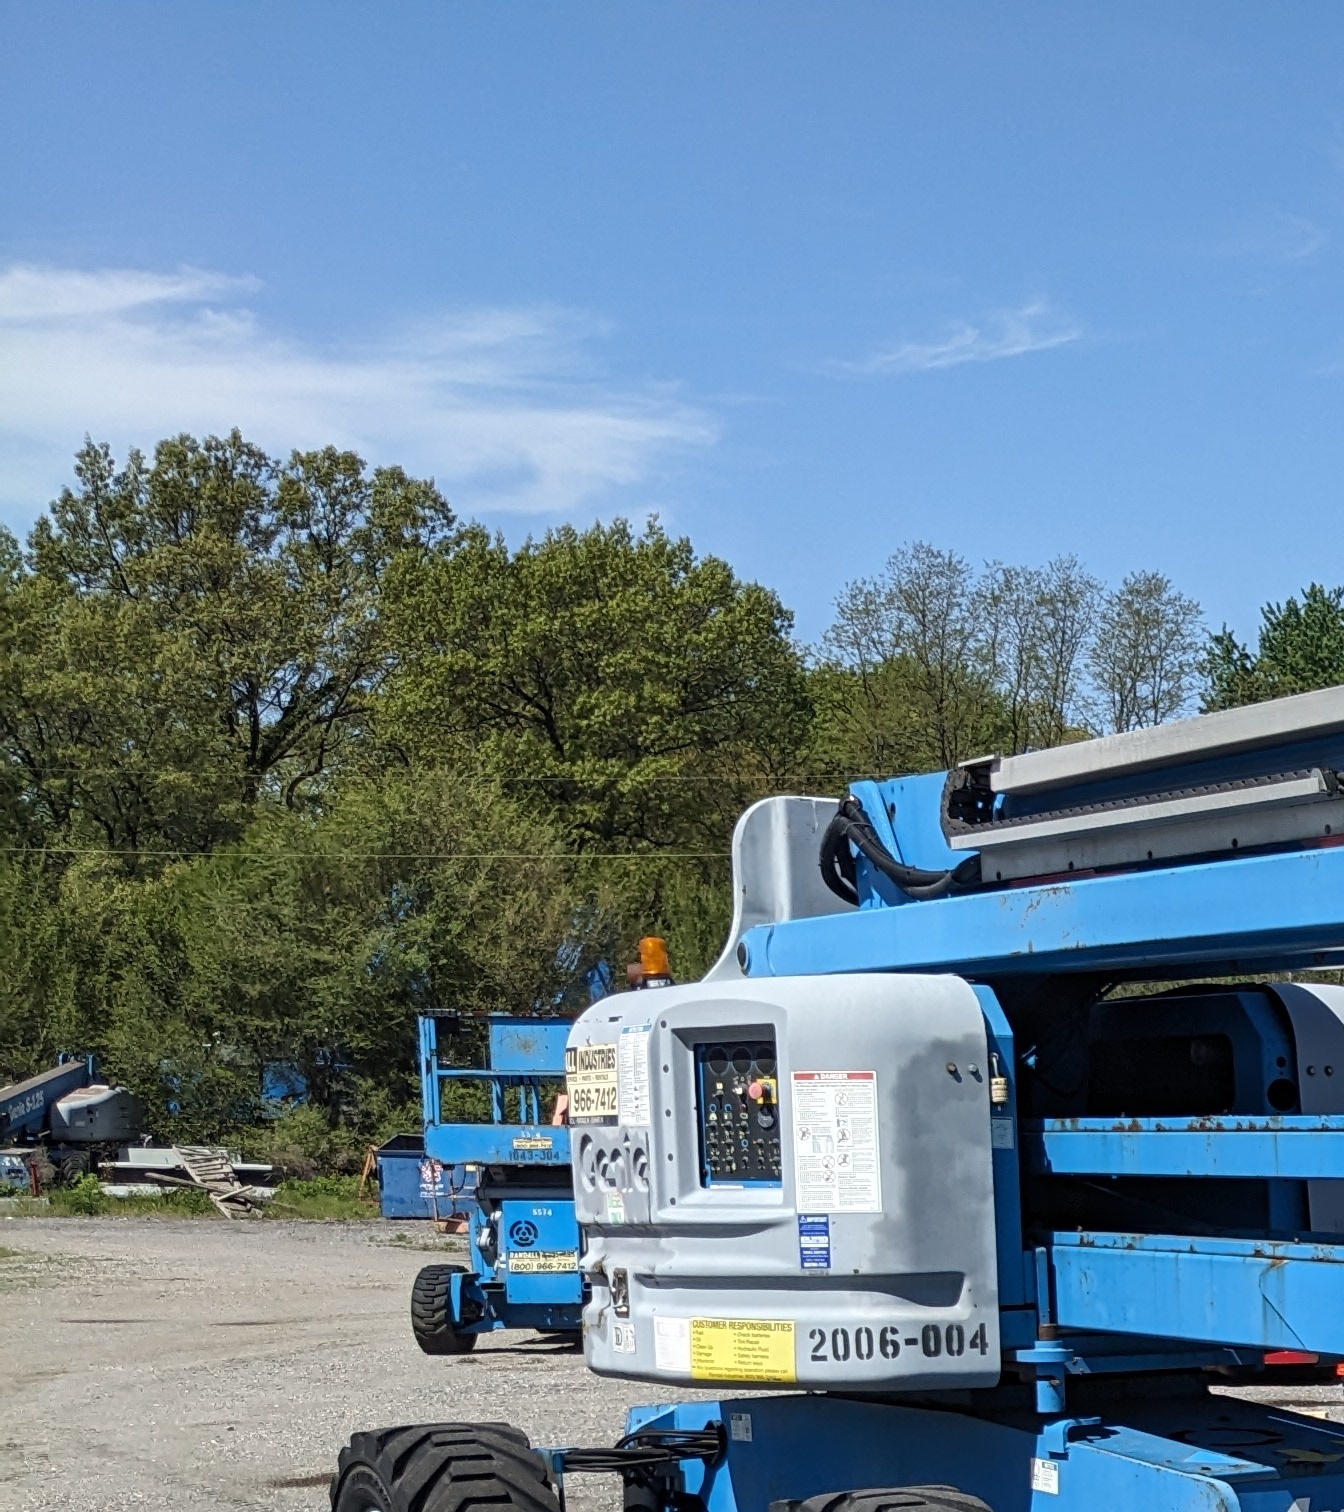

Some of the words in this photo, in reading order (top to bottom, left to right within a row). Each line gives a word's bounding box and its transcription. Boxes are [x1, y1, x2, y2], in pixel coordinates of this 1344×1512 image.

[579, 1047, 616, 1071] INDUSTRIES
[574, 1086, 617, 1112] 966-7412
[511, 1262, 534, 1271] (800)
[692, 1320, 727, 1330] CUSTOMER
[728, 1321, 793, 1332] RESPONSIBILITIES
[809, 1322, 989, 1362] 2006-004
